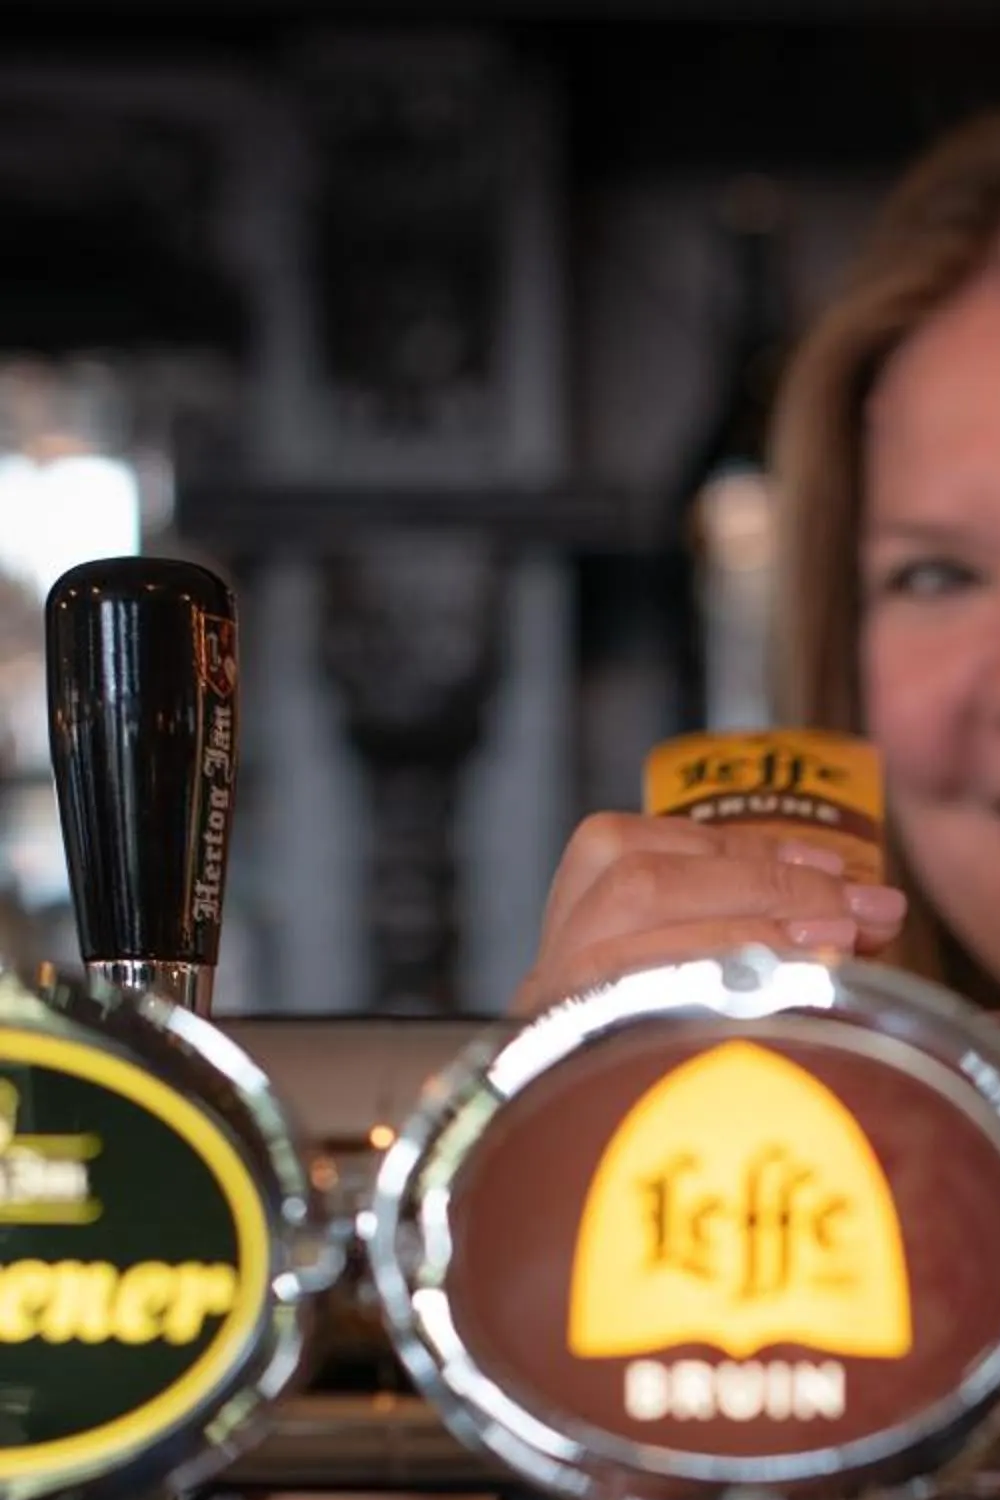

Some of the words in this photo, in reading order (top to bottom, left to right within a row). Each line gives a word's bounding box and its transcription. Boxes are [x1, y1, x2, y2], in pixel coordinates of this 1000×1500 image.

[203, 704, 236, 783] Jan
[673, 748, 850, 791] Leffe
[193, 785, 230, 924] Hertog
[638, 1143, 858, 1302] Leffe
[624, 1359, 846, 1422] BRUIN
